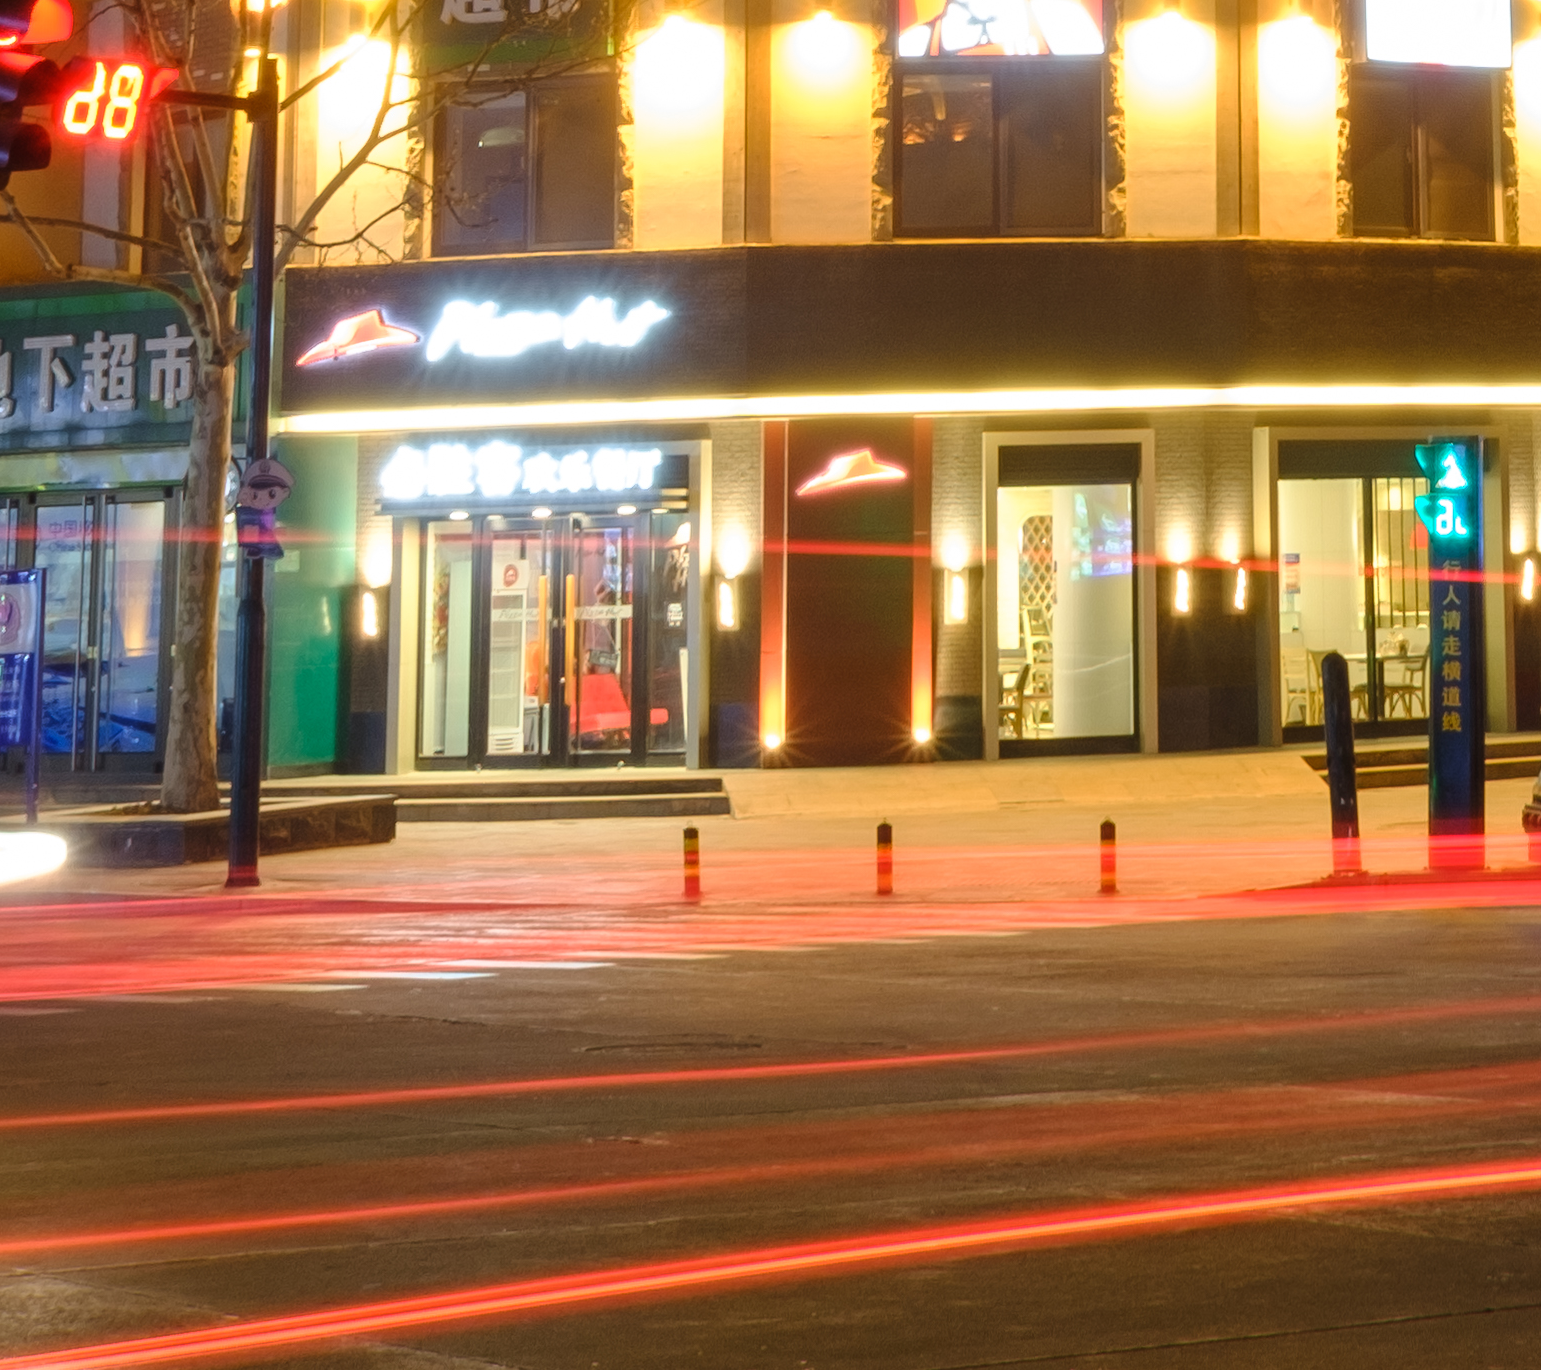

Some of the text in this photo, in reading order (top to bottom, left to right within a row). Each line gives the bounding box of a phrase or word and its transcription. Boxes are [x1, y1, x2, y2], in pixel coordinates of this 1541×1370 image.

[1440, 560, 1462, 733] 行人请走横道线
